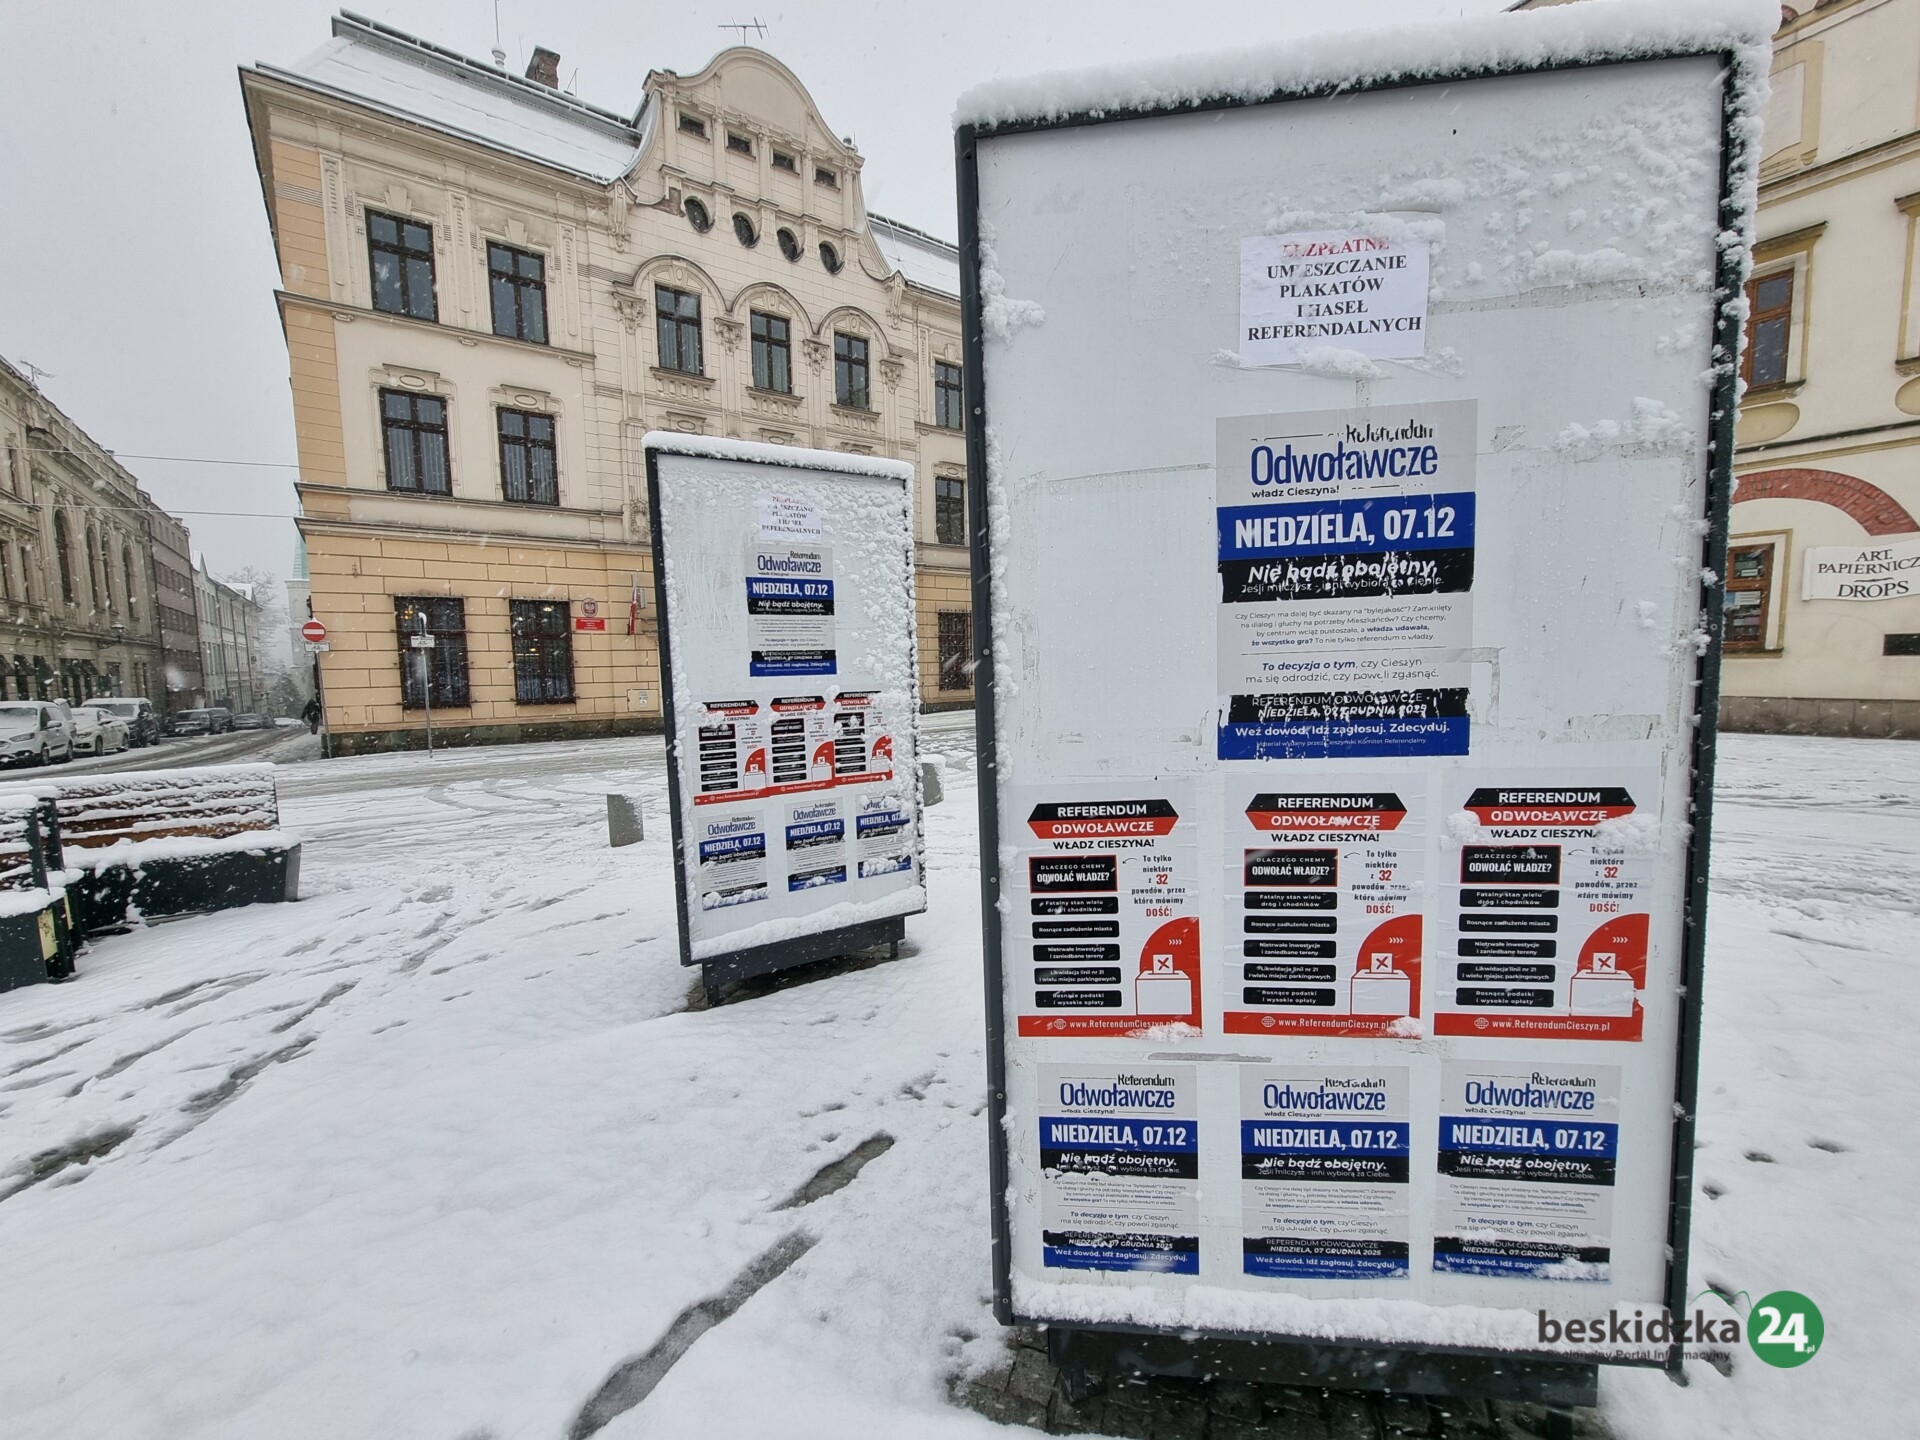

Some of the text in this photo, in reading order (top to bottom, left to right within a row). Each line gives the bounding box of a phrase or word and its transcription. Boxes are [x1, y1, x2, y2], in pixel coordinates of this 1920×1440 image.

[1267, 255, 1407, 279] UMESZCZANIE
[1280, 277, 1384, 298] PLAKATÓW
[1297, 300, 1368, 317] I HASEŁ
[1248, 317, 1421, 340] REFERENDALNYCH
[1251, 441, 1438, 485] Odwoławcze
[1252, 486, 1339, 498] władz Cieszyna!
[1235, 507, 1455, 548] NIEDZIELA, 07.12
[1856, 549, 1893, 561] ART.
[758, 555, 821, 573] Odwoławcze
[1248, 564, 1281, 583] Nie
[753, 582, 828, 596] NIEDZIELA, 07.12
[1838, 581, 1909, 598] DROPS
[1262, 663, 1275, 671] To
[1278, 661, 1320, 672] decyzja
[1334, 659, 1358, 670] tym,
[1361, 660, 1378, 670] czy
[1382, 657, 1422, 669] Cieszyn
[1245, 676, 1262, 684] ma
[1265, 672, 1279, 684] się
[1282, 671, 1330, 683] odrodzić,
[1333, 673, 1350, 683] czy
[1392, 668, 1439, 680] zgasnąć.
[1252, 696, 1331, 706] REFERENDUM
[1258, 707, 1320, 718] NIEDZIELA,
[1235, 721, 1450, 736] Weź dowód. Idź zagłosuj. Zdecyduj.
[1278, 798, 1374, 808] REFERENDUM
[1499, 792, 1600, 803] REFERENDUM
[793, 807, 836, 820] Odwoławcze
[1058, 804, 1147, 817] REFERENDUM
[1491, 810, 1607, 821] ODWOŁAWCZE
[1271, 815, 1380, 826] ODWOŁAWCZE
[708, 821, 756, 835] Odwoławcze
[1052, 821, 1154, 834] ODWOŁAWCZE
[1491, 830, 1537, 838] WŁADZ
[1272, 833, 1379, 842] WŁADZ CIESZYNA!
[704, 836, 761, 853] NIEDZIELA, 07.12
[1053, 839, 1154, 850] WŁADZ CIESZYNA!
[1252, 864, 1329, 875] ODWOŁAĆ WŁADZE?
[1365, 861, 1397, 869] niektóre
[1469, 861, 1552, 872] ODWOŁAĆ WŁADZE?
[1037, 871, 1109, 883] ODWOŁAĆ WŁADZE?
[1156, 874, 1168, 884] 32
[1378, 870, 1391, 881] 32
[1604, 867, 1618, 878] 32
[1146, 908, 1172, 917] DOŚĆ!
[1366, 904, 1394, 913] DOŚĆ!
[1590, 903, 1619, 913] DOŚĆ!
[1279, 1019, 1389, 1030] www.ReferendumCieszyn.pl
[1492, 1020, 1610, 1031] www.ReferendumCieszyn.pl
[1118, 1074, 1174, 1086] Referendum
[1060, 1082, 1175, 1108] Odwoławcze
[1264, 1084, 1386, 1111] Odwoławcze
[1466, 1081, 1594, 1110] Odwoławcze
[1051, 1124, 1186, 1146] NIEDZIELA, 07.12
[1254, 1128, 1397, 1151] NIEDZIELA, 07.12
[1453, 1124, 1605, 1150] NIEDZIELA, 07.12
[1061, 1153, 1080, 1163] Nie
[1118, 1155, 1176, 1166] obojętny.
[1263, 1158, 1386, 1170] Nie bądź obojętny.
[1460, 1155, 1483, 1165] Nie
[1525, 1160, 1591, 1172] obojętny.
